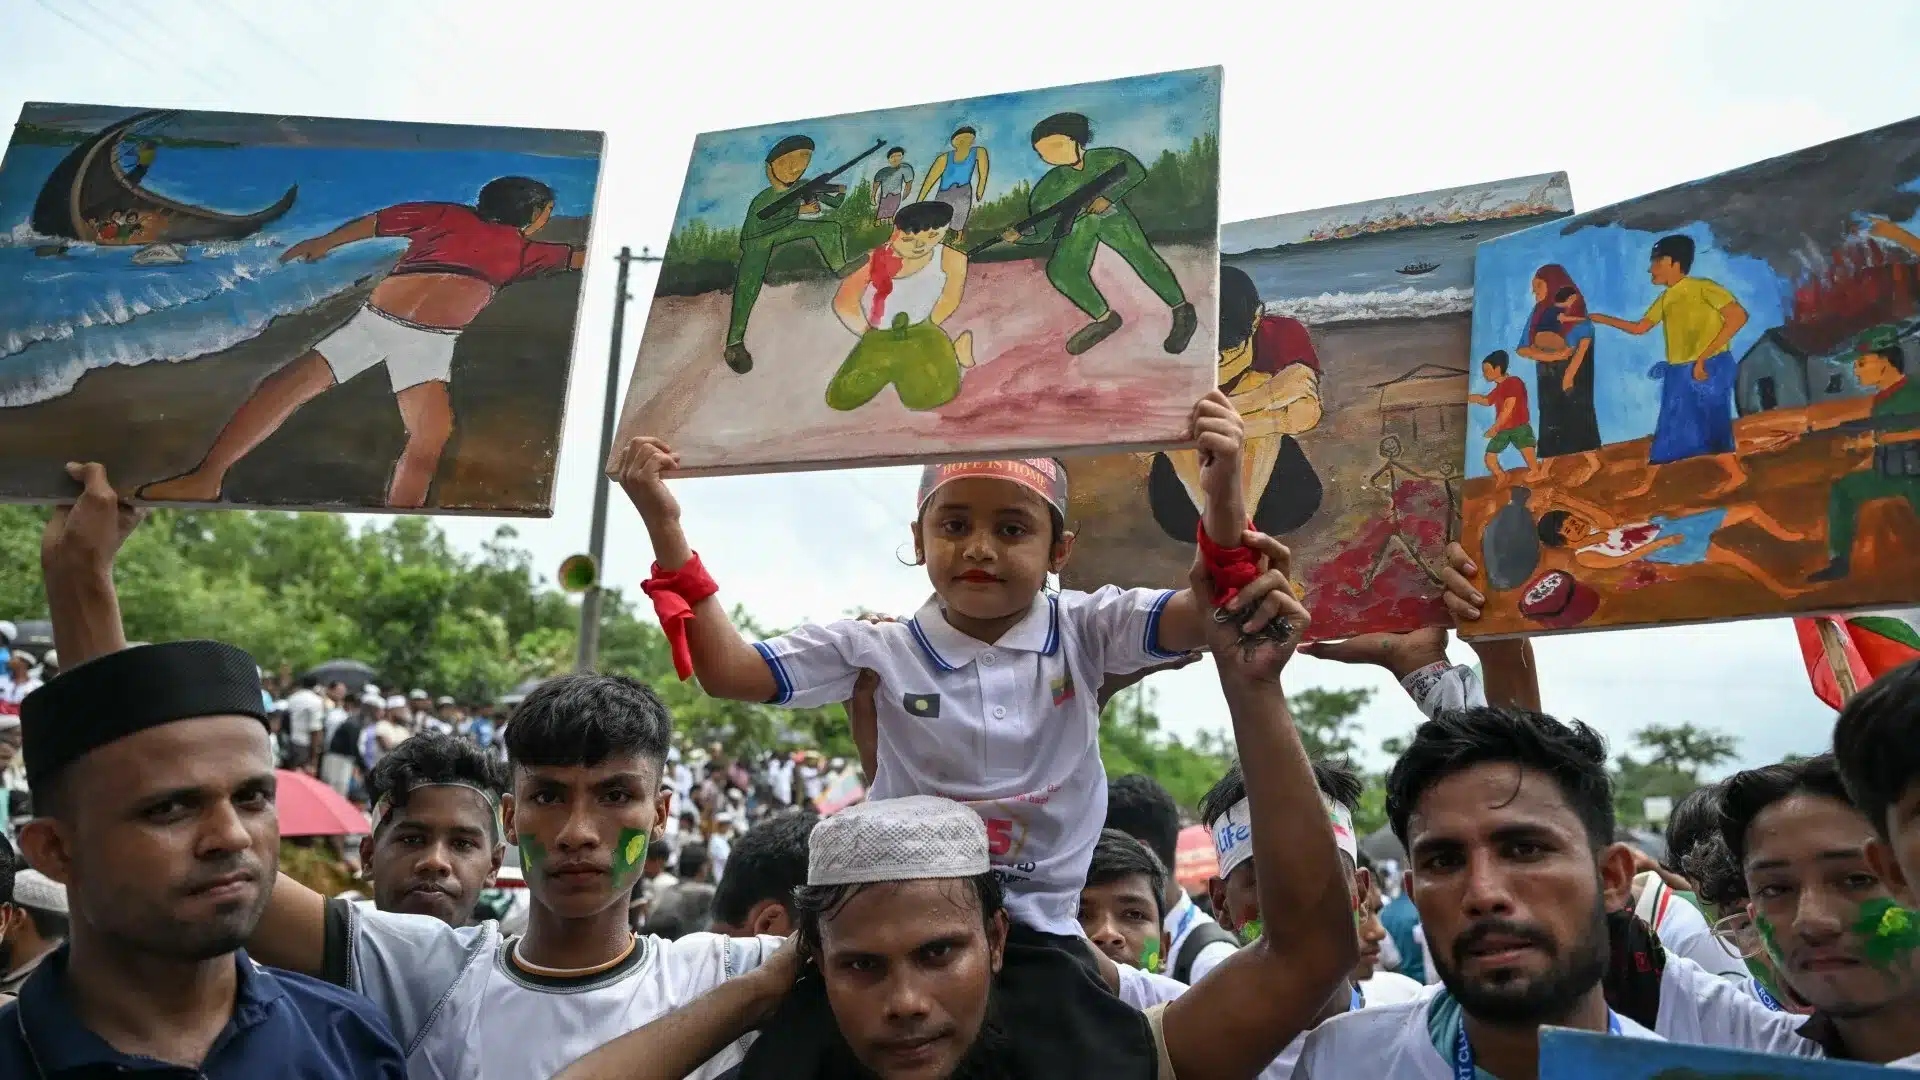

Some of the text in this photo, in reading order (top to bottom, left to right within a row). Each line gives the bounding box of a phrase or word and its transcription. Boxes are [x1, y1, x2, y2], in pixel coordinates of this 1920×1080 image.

[943, 460, 1048, 489] HOPE IS HOME
